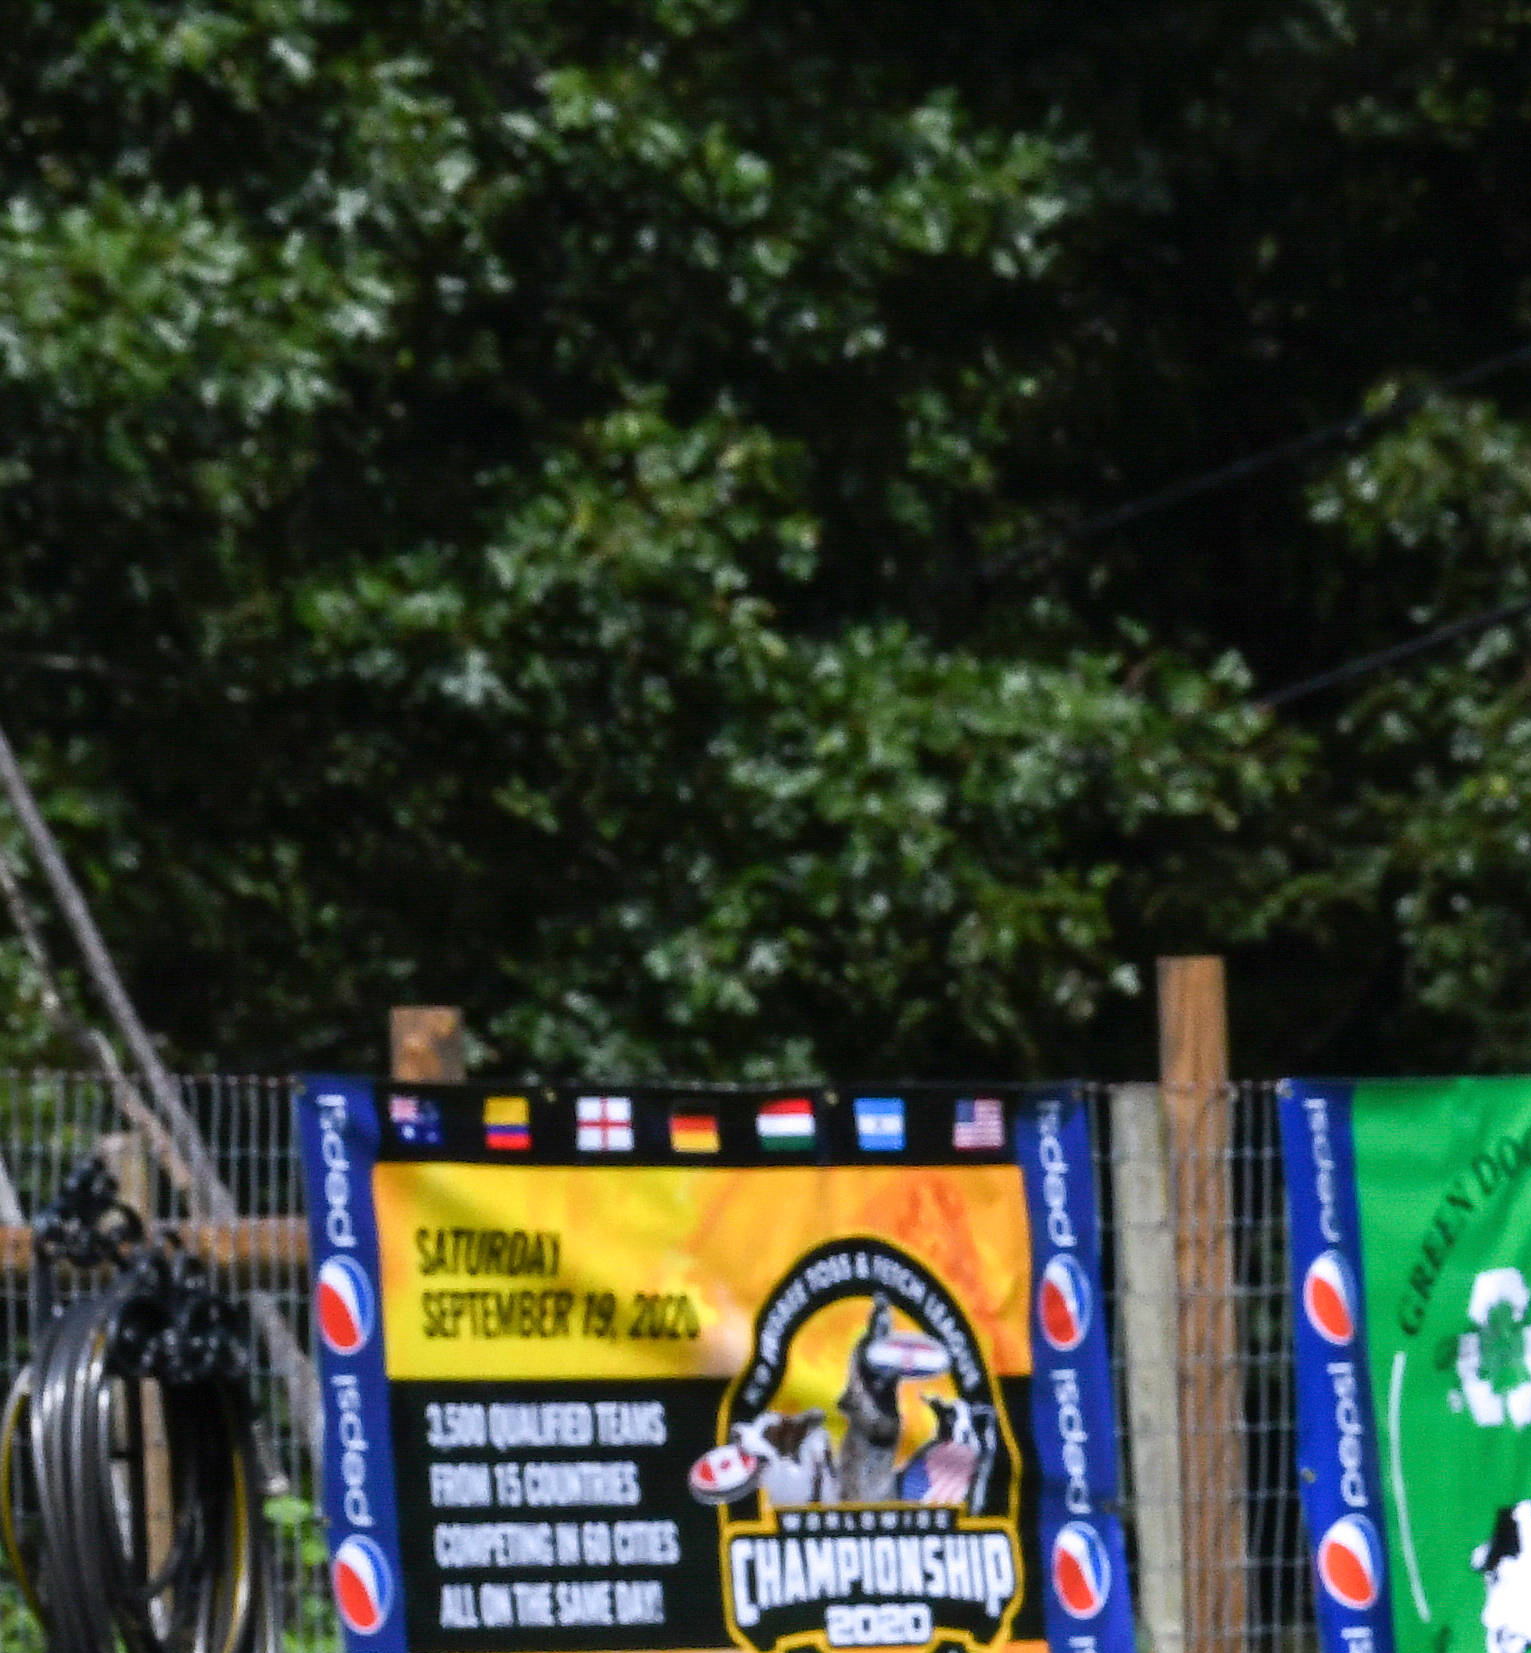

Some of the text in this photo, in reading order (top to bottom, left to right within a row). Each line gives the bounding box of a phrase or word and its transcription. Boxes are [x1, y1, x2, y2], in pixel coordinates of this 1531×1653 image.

[315, 1094, 356, 1247] pepsi
[1036, 1100, 1077, 1247] pepsi
[1303, 1098, 1342, 1243] pepsi
[416, 1228, 561, 1276] SATURDAY
[421, 1290, 575, 1339] SEPTEMBER
[628, 1290, 700, 1340] 2020
[331, 1375, 376, 1527] pepsi
[488, 1401, 594, 1451] QUALIFIED
[595, 1400, 667, 1446] TEAMS
[1052, 1367, 1092, 1514] pepsi
[1328, 1362, 1369, 1507] pepsi
[429, 1460, 642, 1507] FROM 15 COUNTRIES
[434, 1521, 555, 1568] COMPETING
[555, 1521, 581, 1567] IN
[614, 1519, 681, 1566] CITIES
[730, 1532, 1015, 1628] CHAMPIONSHIP
[440, 1582, 480, 1629] ALL
[480, 1582, 513, 1629] ON
[513, 1581, 554, 1627] THE
[556, 1580, 614, 1626] SAME
[825, 1603, 932, 1647] 2020
